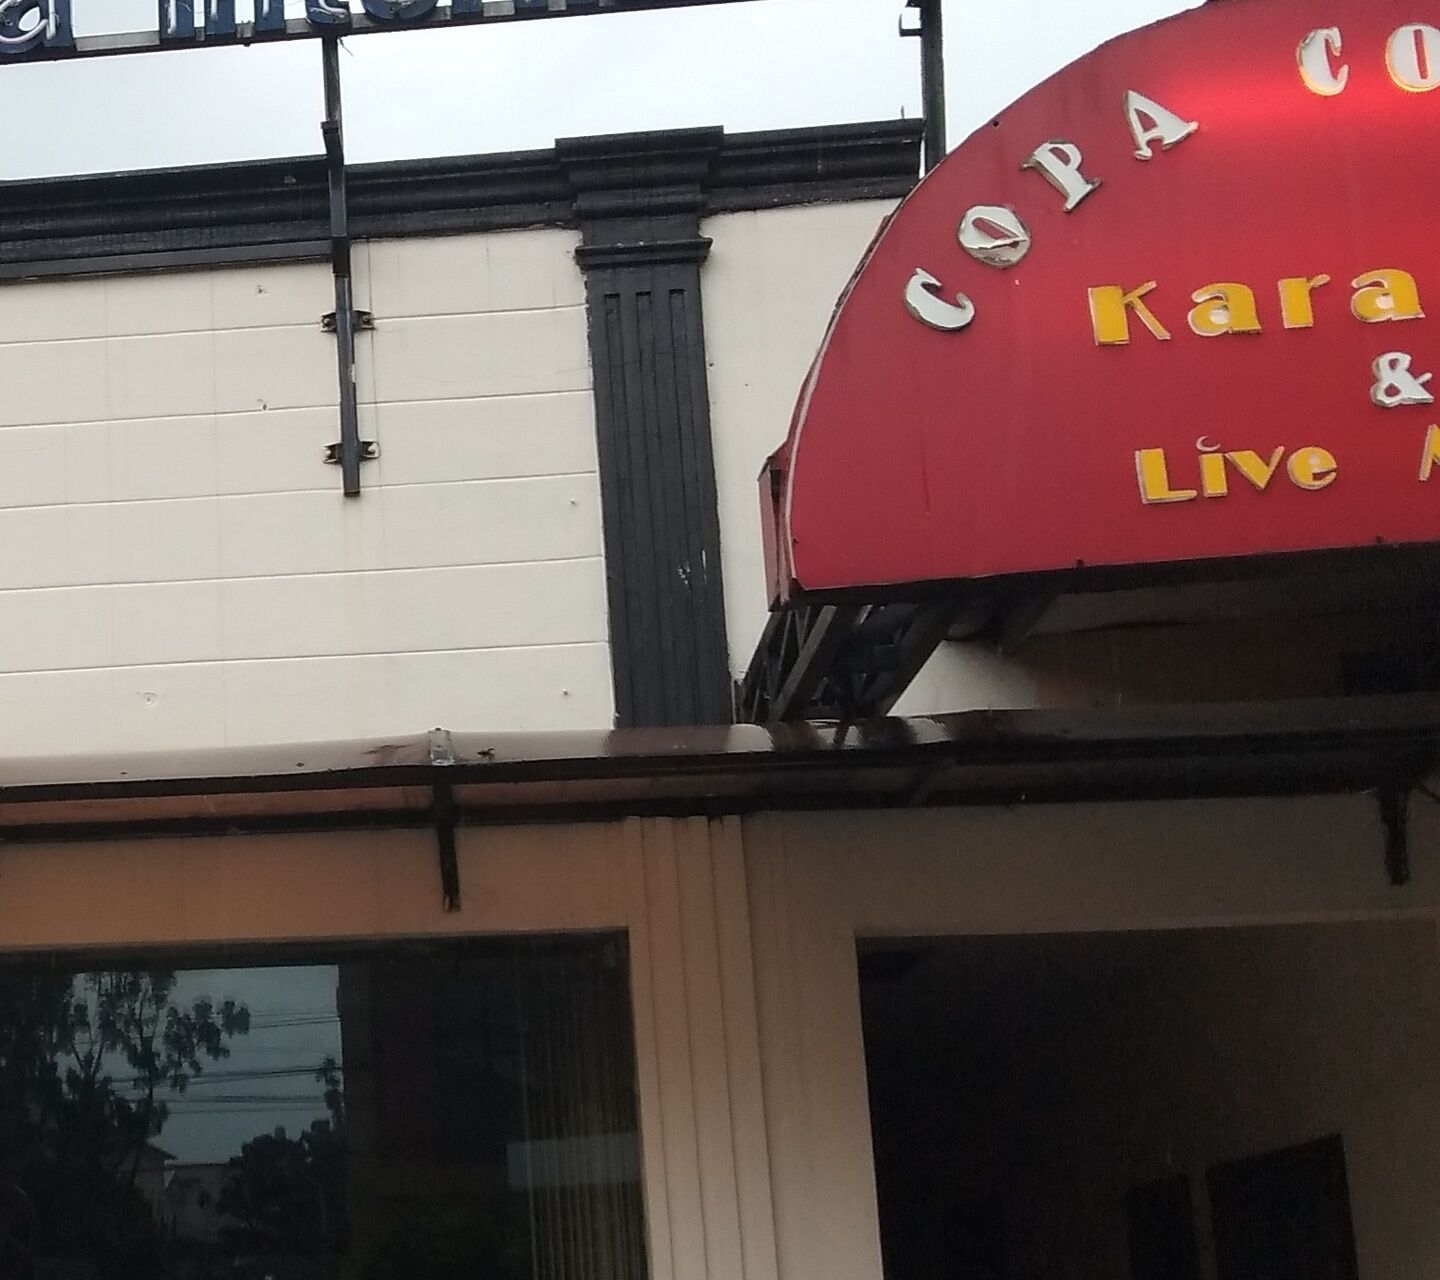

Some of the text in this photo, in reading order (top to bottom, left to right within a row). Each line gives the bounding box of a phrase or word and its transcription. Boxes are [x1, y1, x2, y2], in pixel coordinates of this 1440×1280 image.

[903, 89, 1201, 332] COPA
[1087, 267, 1426, 347] Kara
[1369, 350, 1436, 408] &
[1134, 435, 1339, 505] Live
